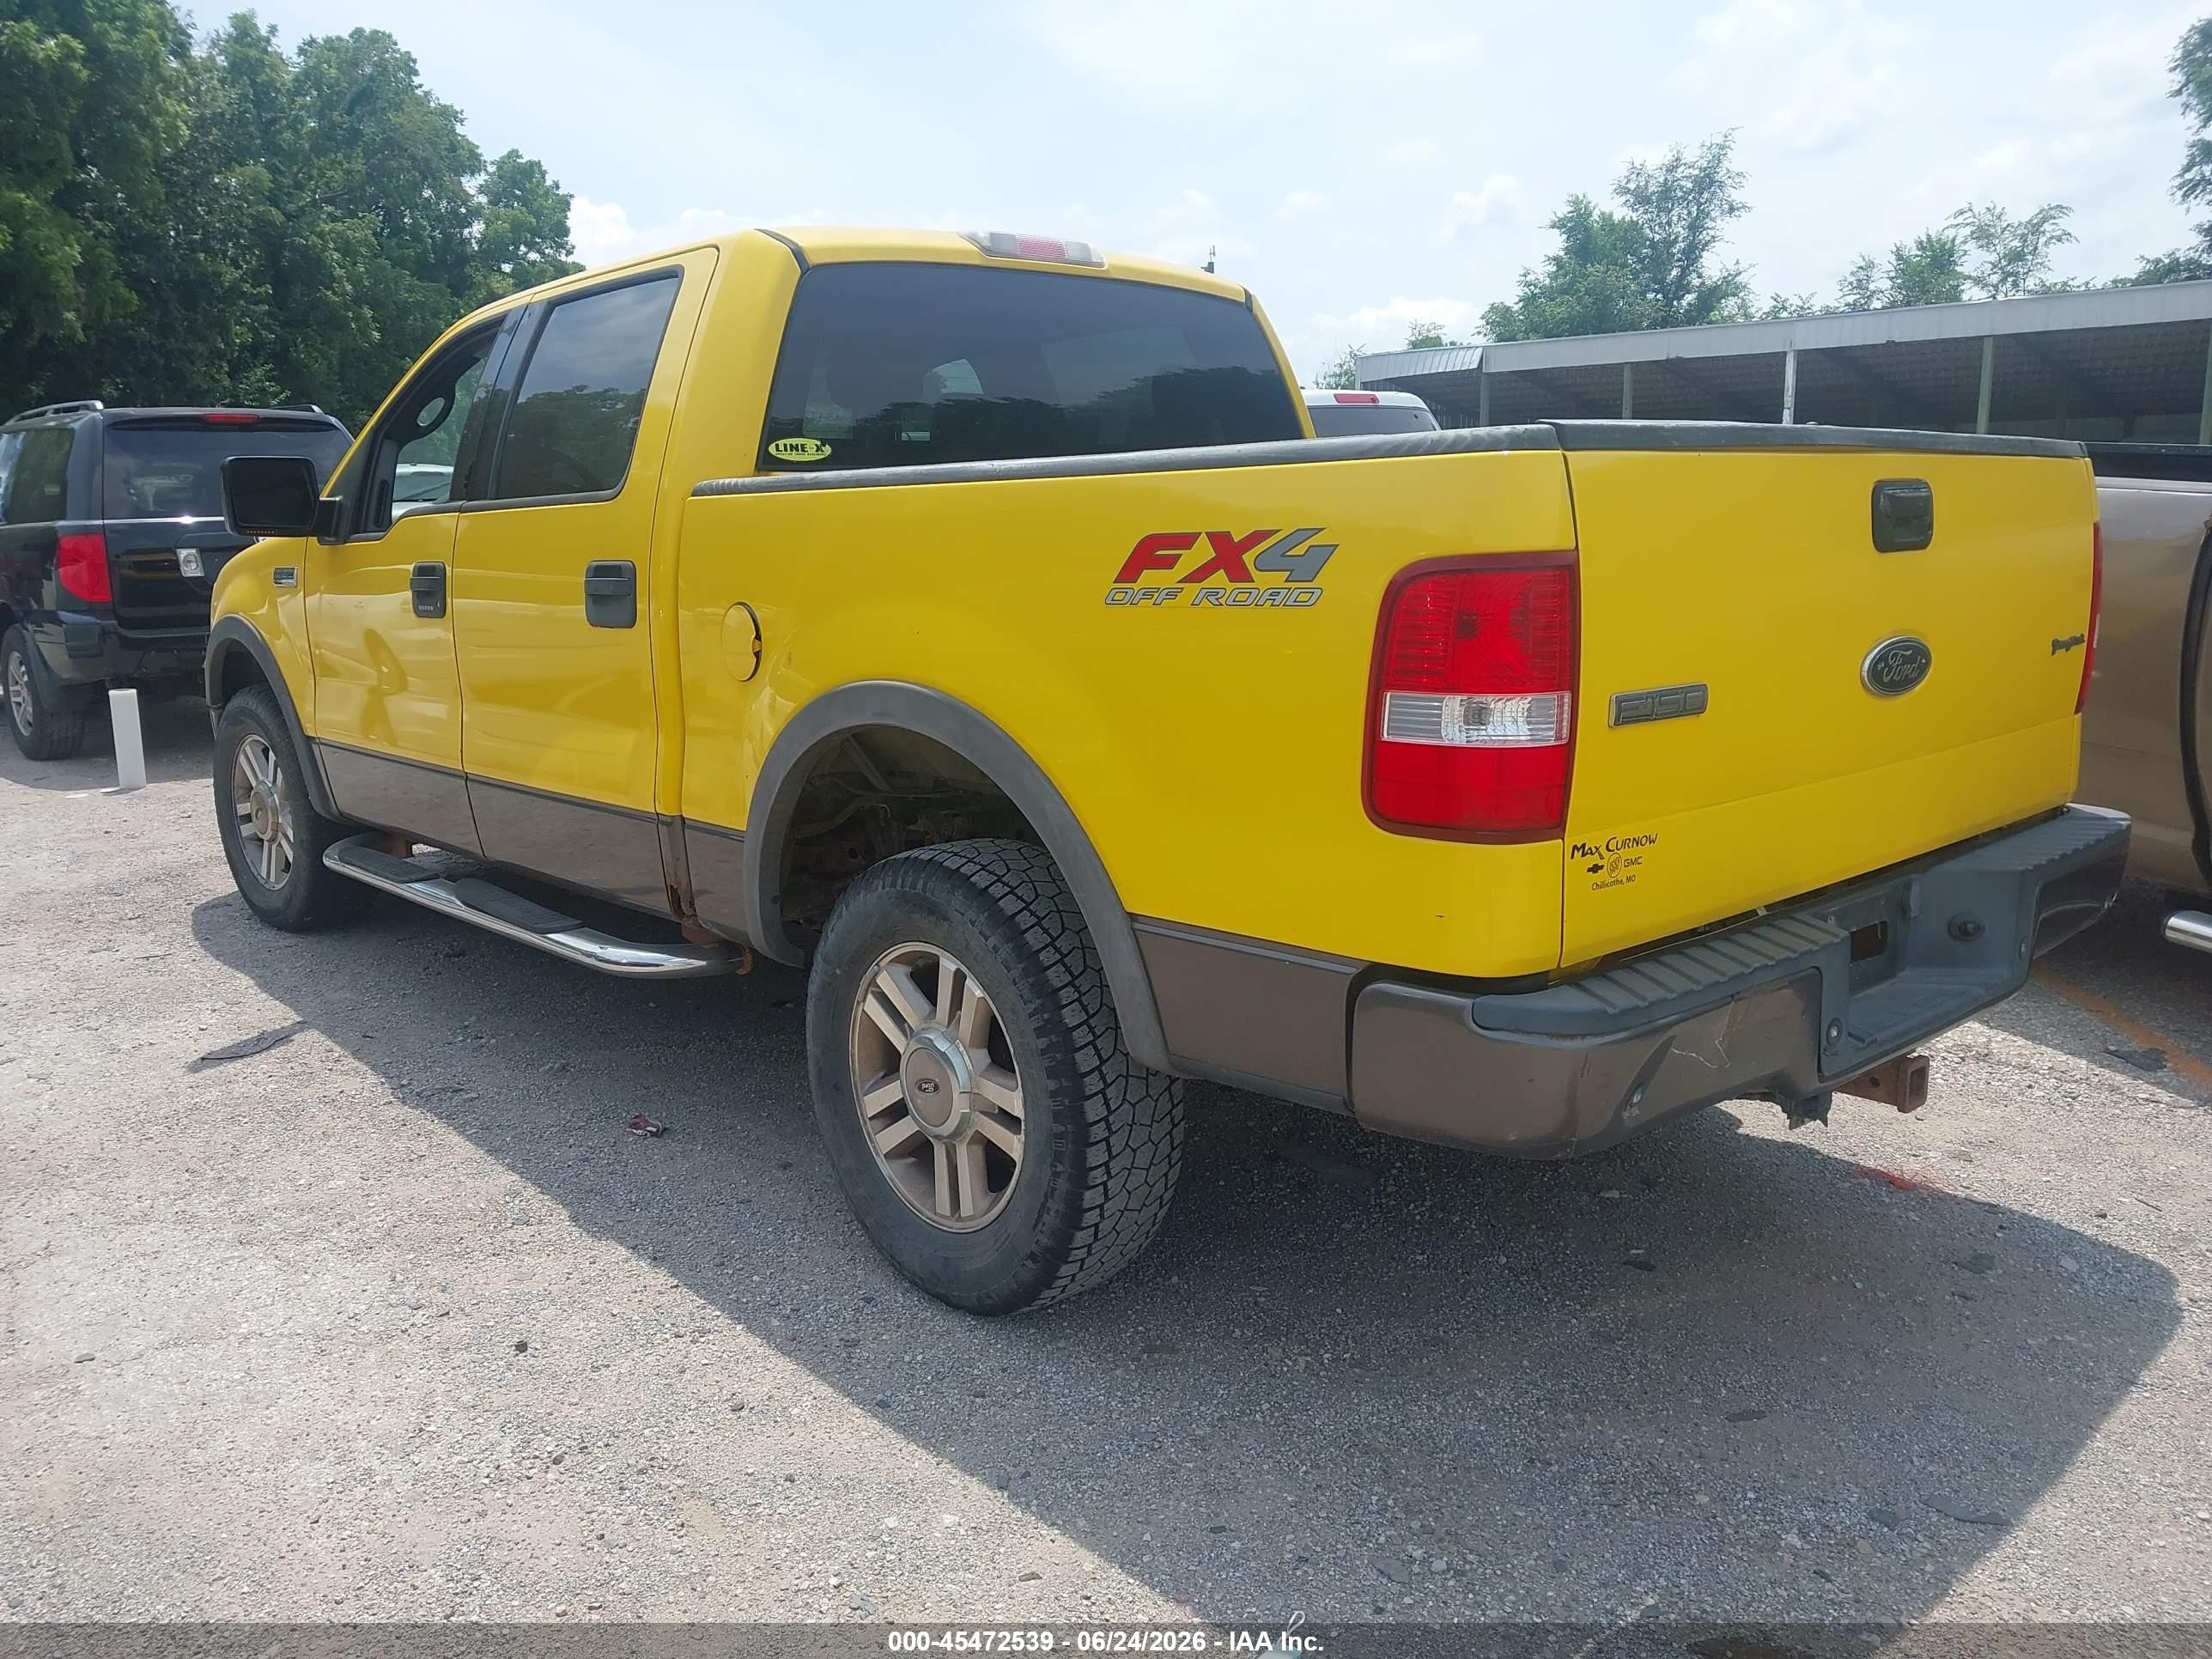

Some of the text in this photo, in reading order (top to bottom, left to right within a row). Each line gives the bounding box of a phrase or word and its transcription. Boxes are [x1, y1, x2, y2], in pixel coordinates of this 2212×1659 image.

[775, 439, 828, 453] LINE-X
[1113, 527, 1340, 584] FX4
[1104, 587, 1323, 607] OFF ROAD
[1882, 649, 1921, 683] Ford
[1623, 856, 1643, 868] GMC
[1626, 874, 1637, 884] MO
